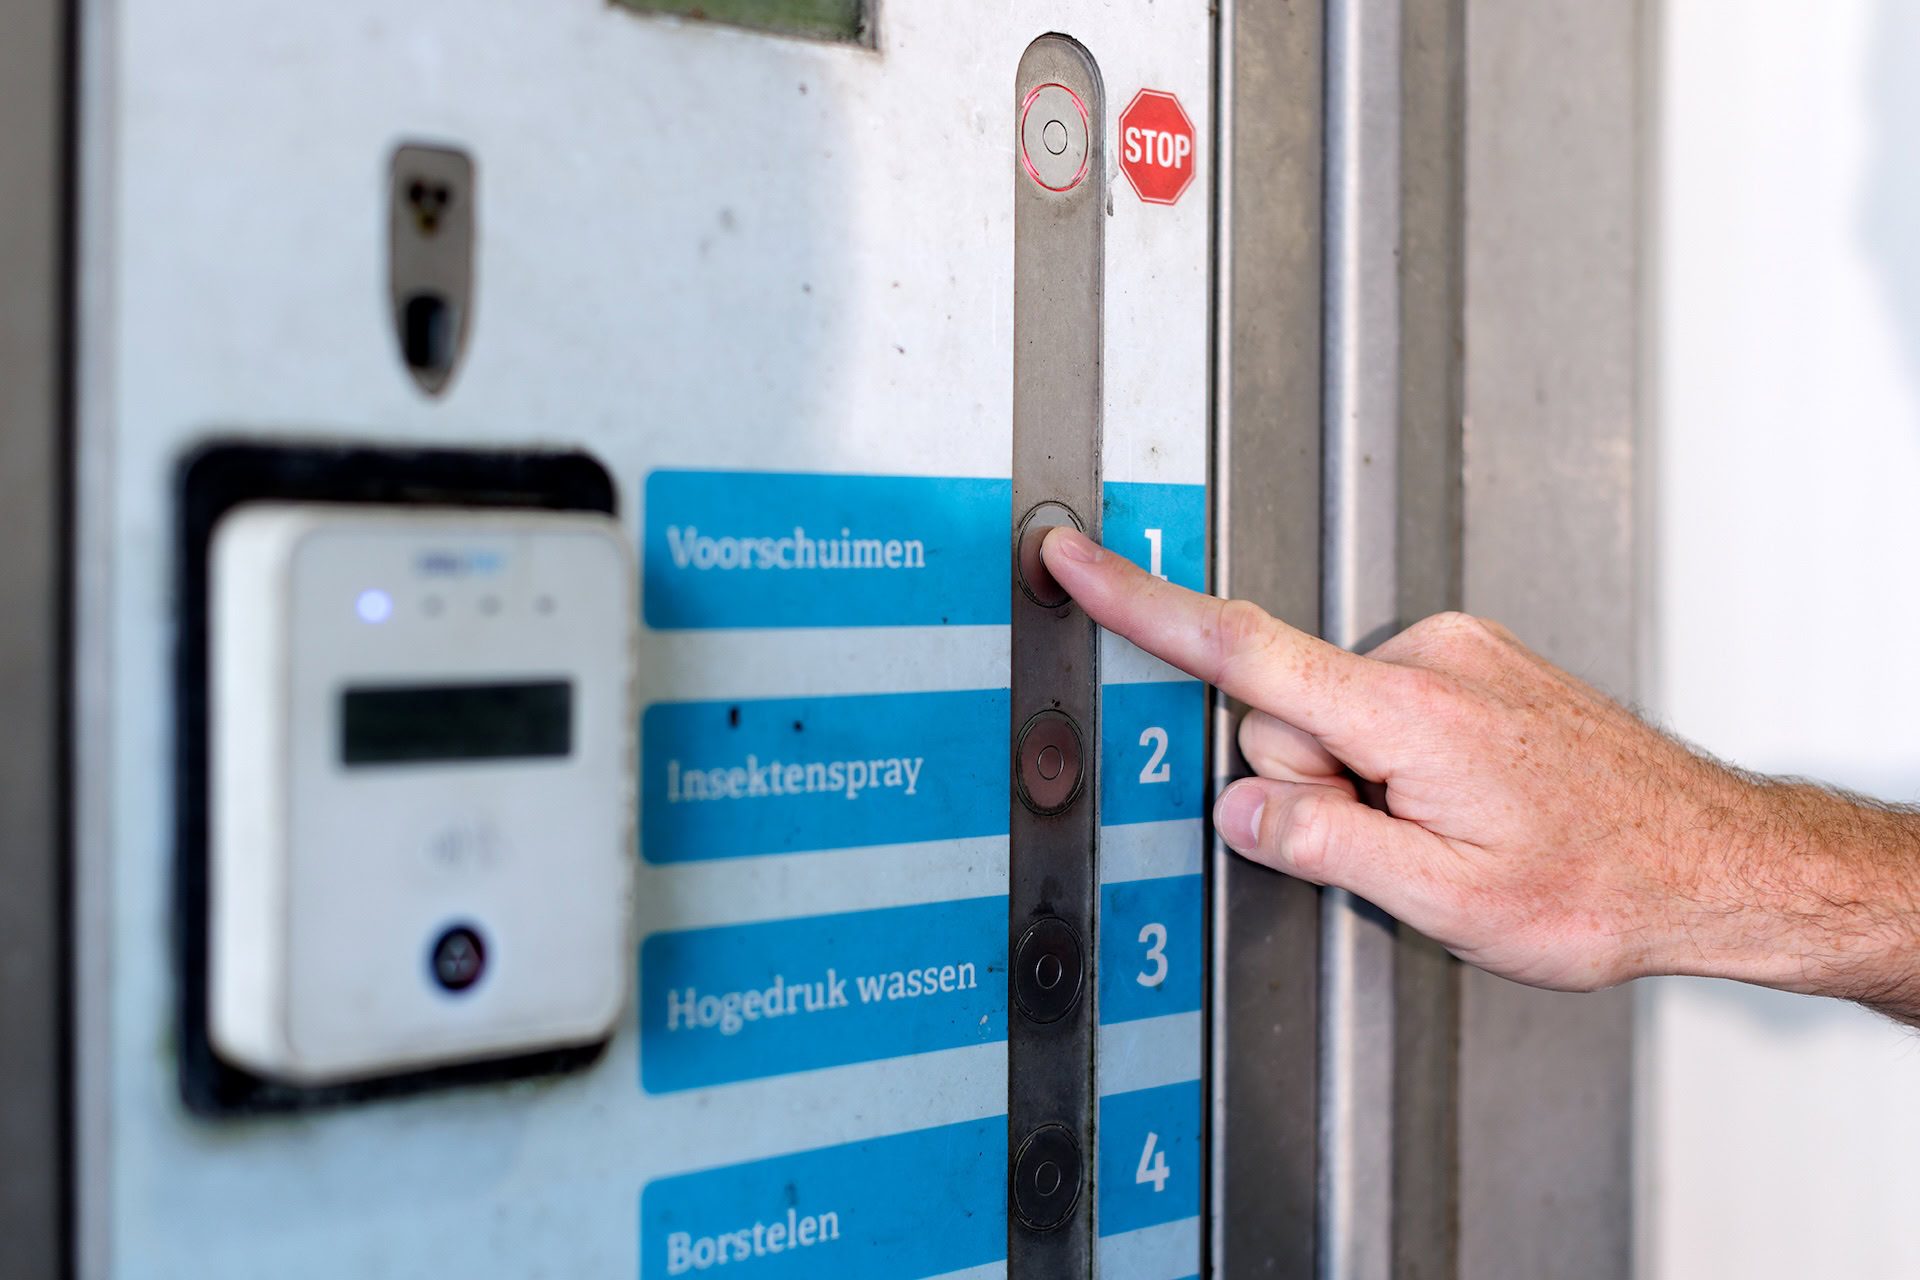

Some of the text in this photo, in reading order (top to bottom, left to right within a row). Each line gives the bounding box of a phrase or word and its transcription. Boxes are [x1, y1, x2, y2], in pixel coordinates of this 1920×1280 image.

[1124, 126, 1191, 169] STOP
[666, 526, 926, 570] Voorschuimen
[1144, 528, 1168, 582] 1
[666, 754, 924, 803] Insektenspray
[1138, 726, 1171, 785] 2
[1136, 922, 1169, 988] 3
[666, 961, 978, 1035] Hogedruk wassen
[1135, 1131, 1171, 1193] 4
[666, 1208, 840, 1275] Borstelen
